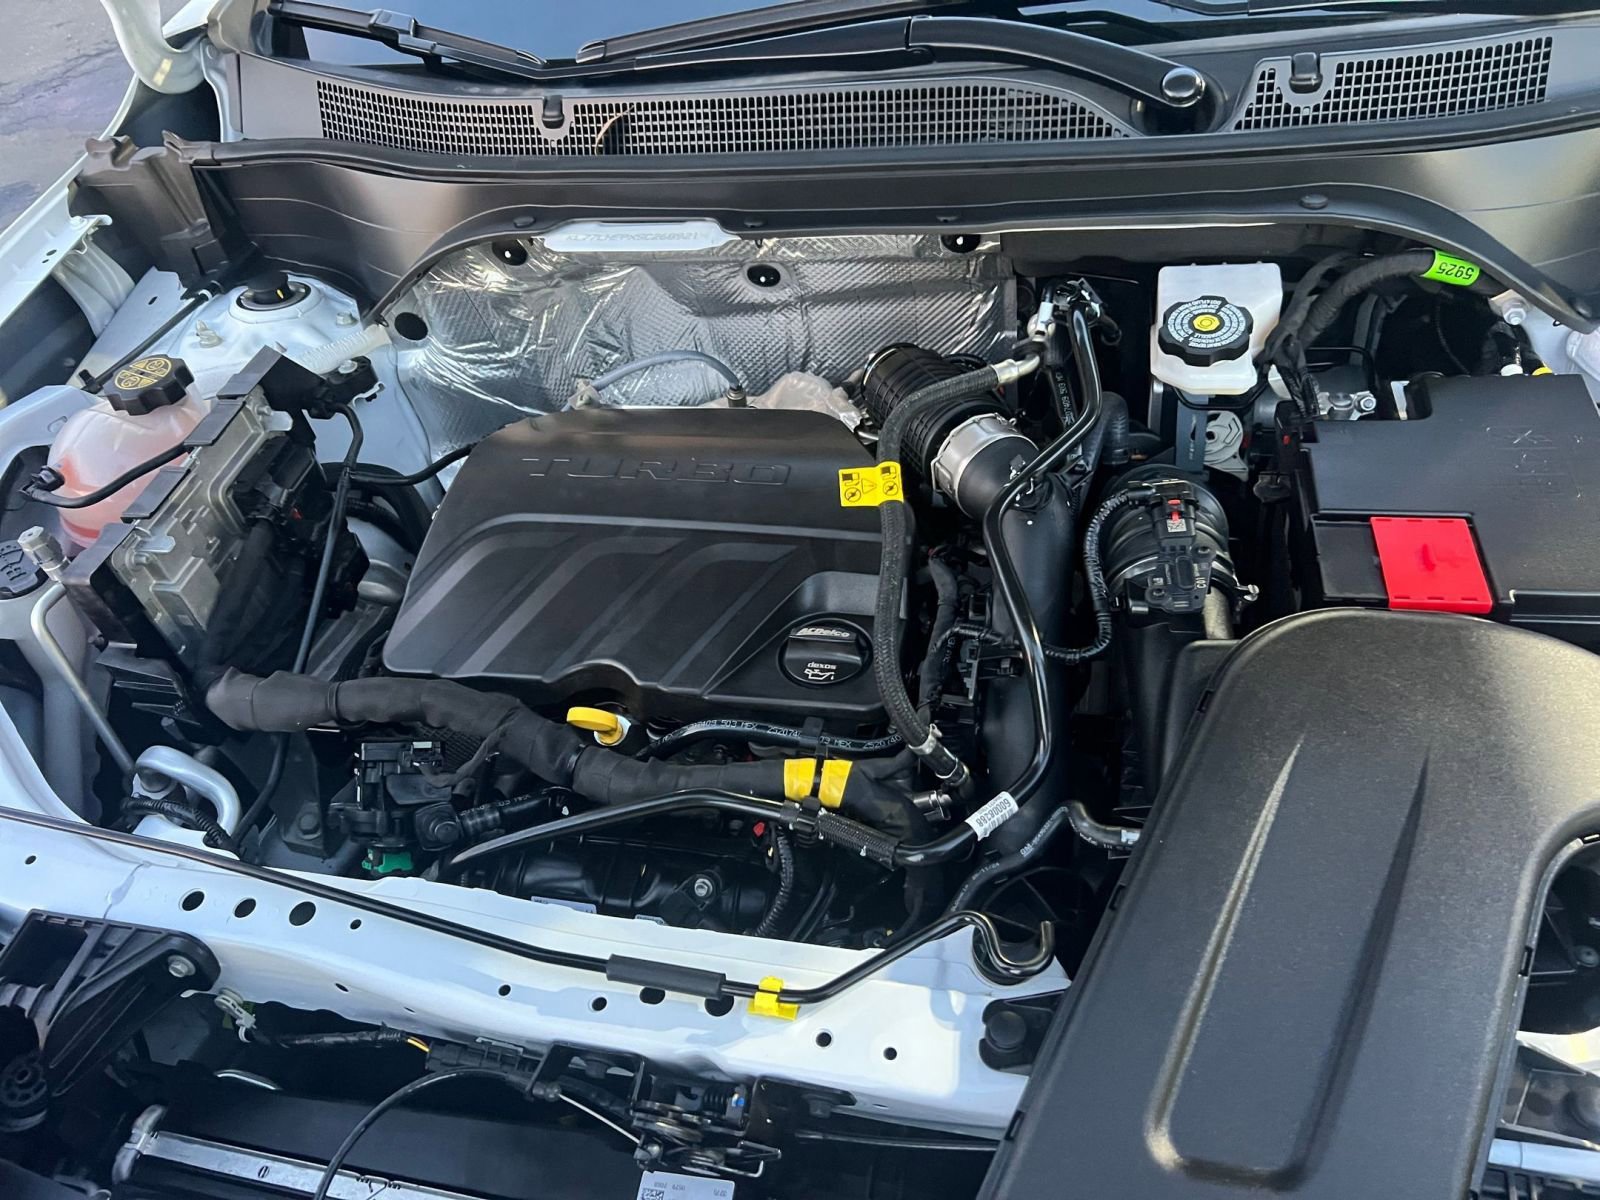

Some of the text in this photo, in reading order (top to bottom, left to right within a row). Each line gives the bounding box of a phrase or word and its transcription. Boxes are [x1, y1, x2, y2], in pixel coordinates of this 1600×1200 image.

[1435, 261, 1475, 281] 5925
[521, 457, 792, 487] TURBO
[795, 627, 851, 638] ACDelco
[807, 661, 837, 670] dexos
[720, 719, 738, 729] 503
